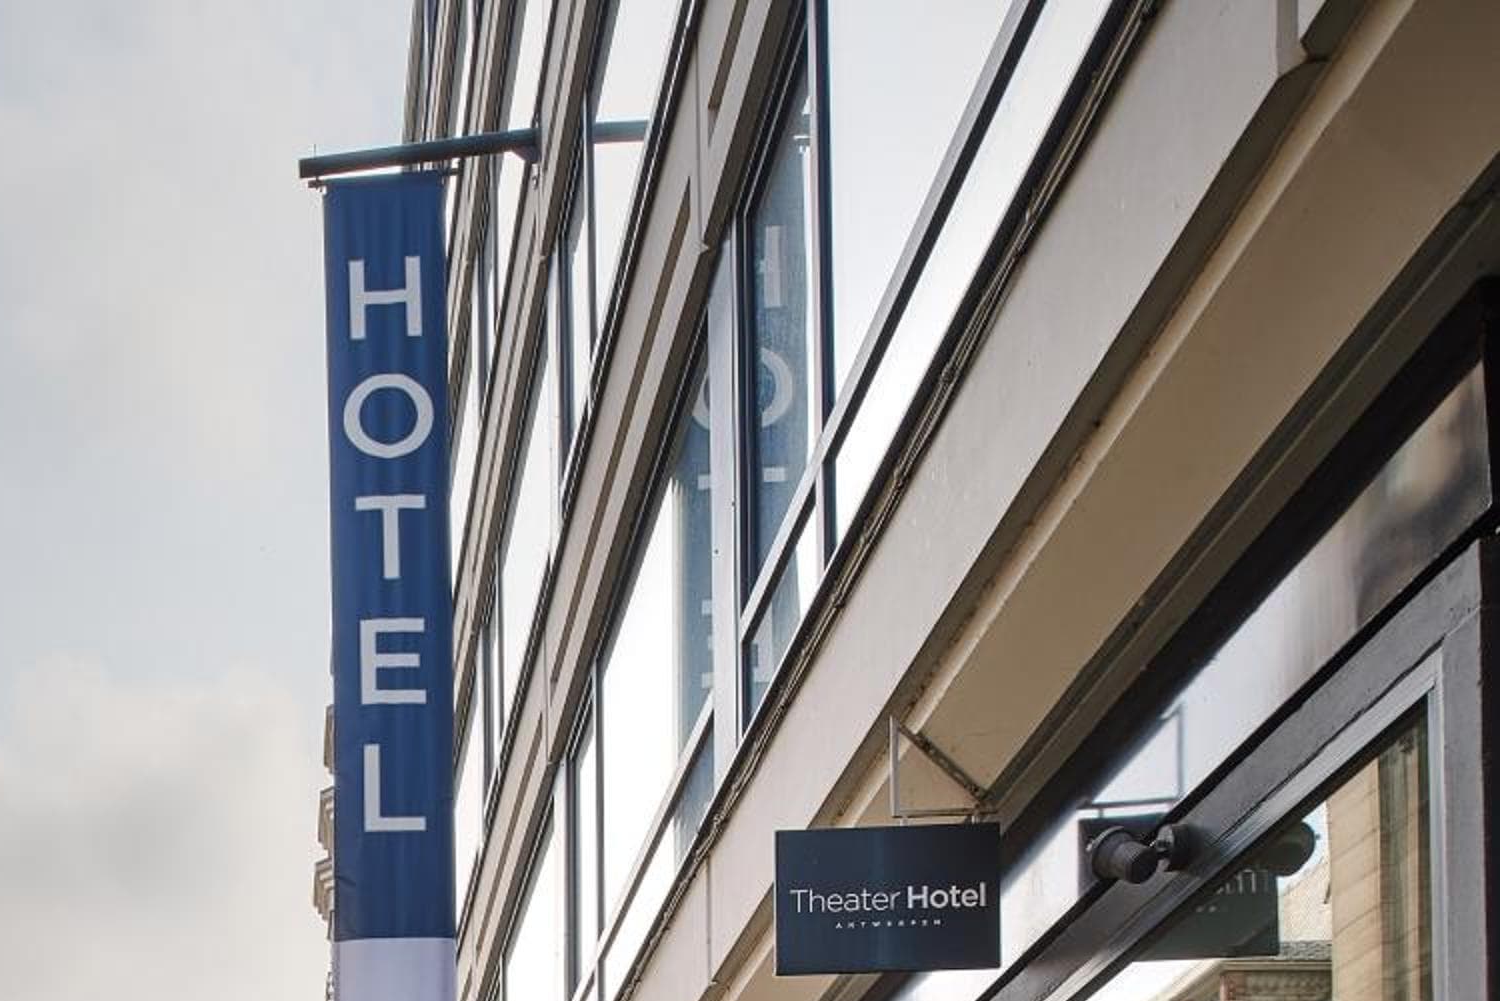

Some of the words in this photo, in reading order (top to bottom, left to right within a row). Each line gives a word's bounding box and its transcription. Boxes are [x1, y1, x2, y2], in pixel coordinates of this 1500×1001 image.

[343, 255, 435, 832] HOTEL
[789, 888, 901, 913] Theater
[907, 881, 987, 909] Hotel
